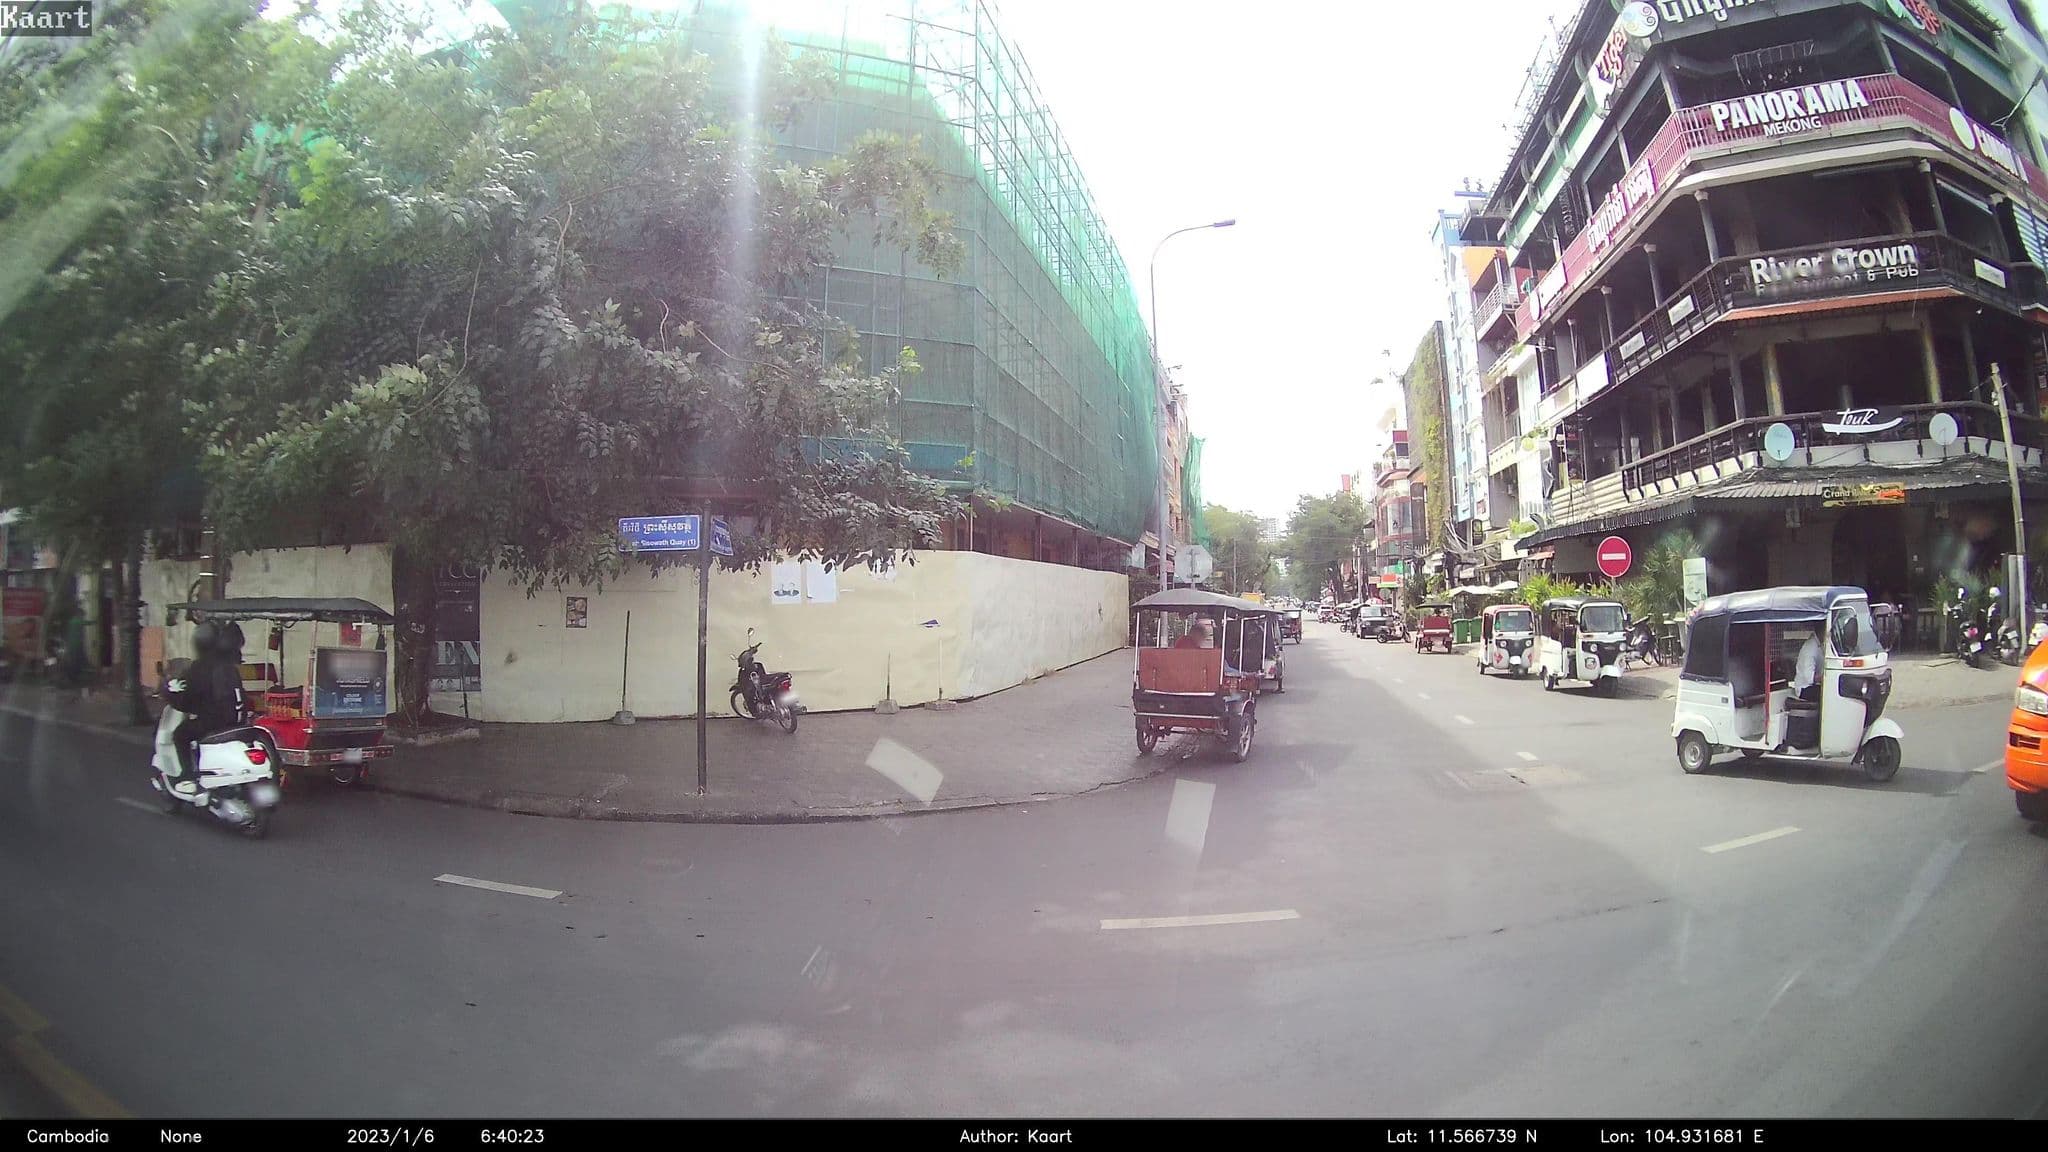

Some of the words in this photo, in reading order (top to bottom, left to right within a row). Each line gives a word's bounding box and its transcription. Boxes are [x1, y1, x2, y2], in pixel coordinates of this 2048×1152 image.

[1709, 79, 1869, 132] PANORAMA
[1763, 115, 1822, 137] MEKONG
[1750, 252, 1822, 284] River
[1832, 244, 1917, 274] Crown
[670, 539, 686, 547] Quay
